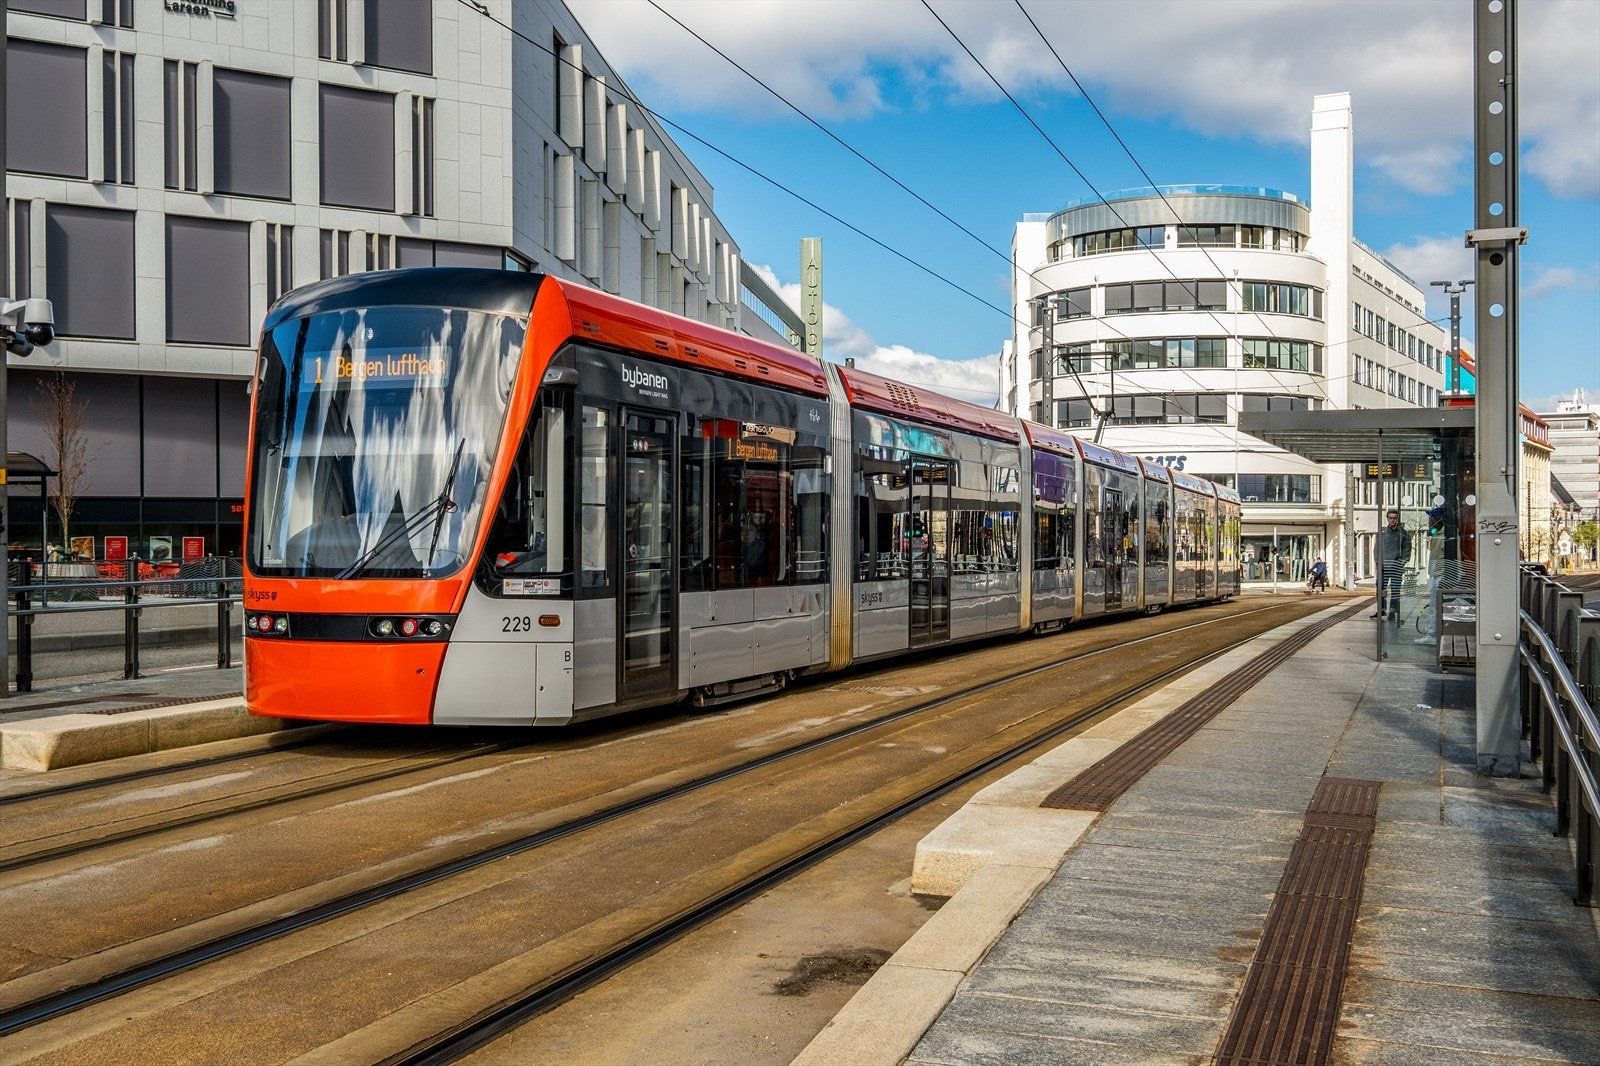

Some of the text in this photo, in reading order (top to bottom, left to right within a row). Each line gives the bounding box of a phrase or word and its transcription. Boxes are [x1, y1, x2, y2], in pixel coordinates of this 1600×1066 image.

[164, 0, 209, 16] Larsen
[807, 258, 819, 353] AUTOG
[315, 357, 323, 383] 1
[335, 356, 383, 381] Bergen
[622, 363, 668, 390] bybanen
[727, 437, 732, 460] 1
[736, 439, 755, 462] Bergen
[231, 504, 244, 513] sø
[247, 588, 271, 602] skyss
[861, 590, 878, 606] skyss
[502, 616, 531, 632] 229
[564, 651, 571, 662] B
